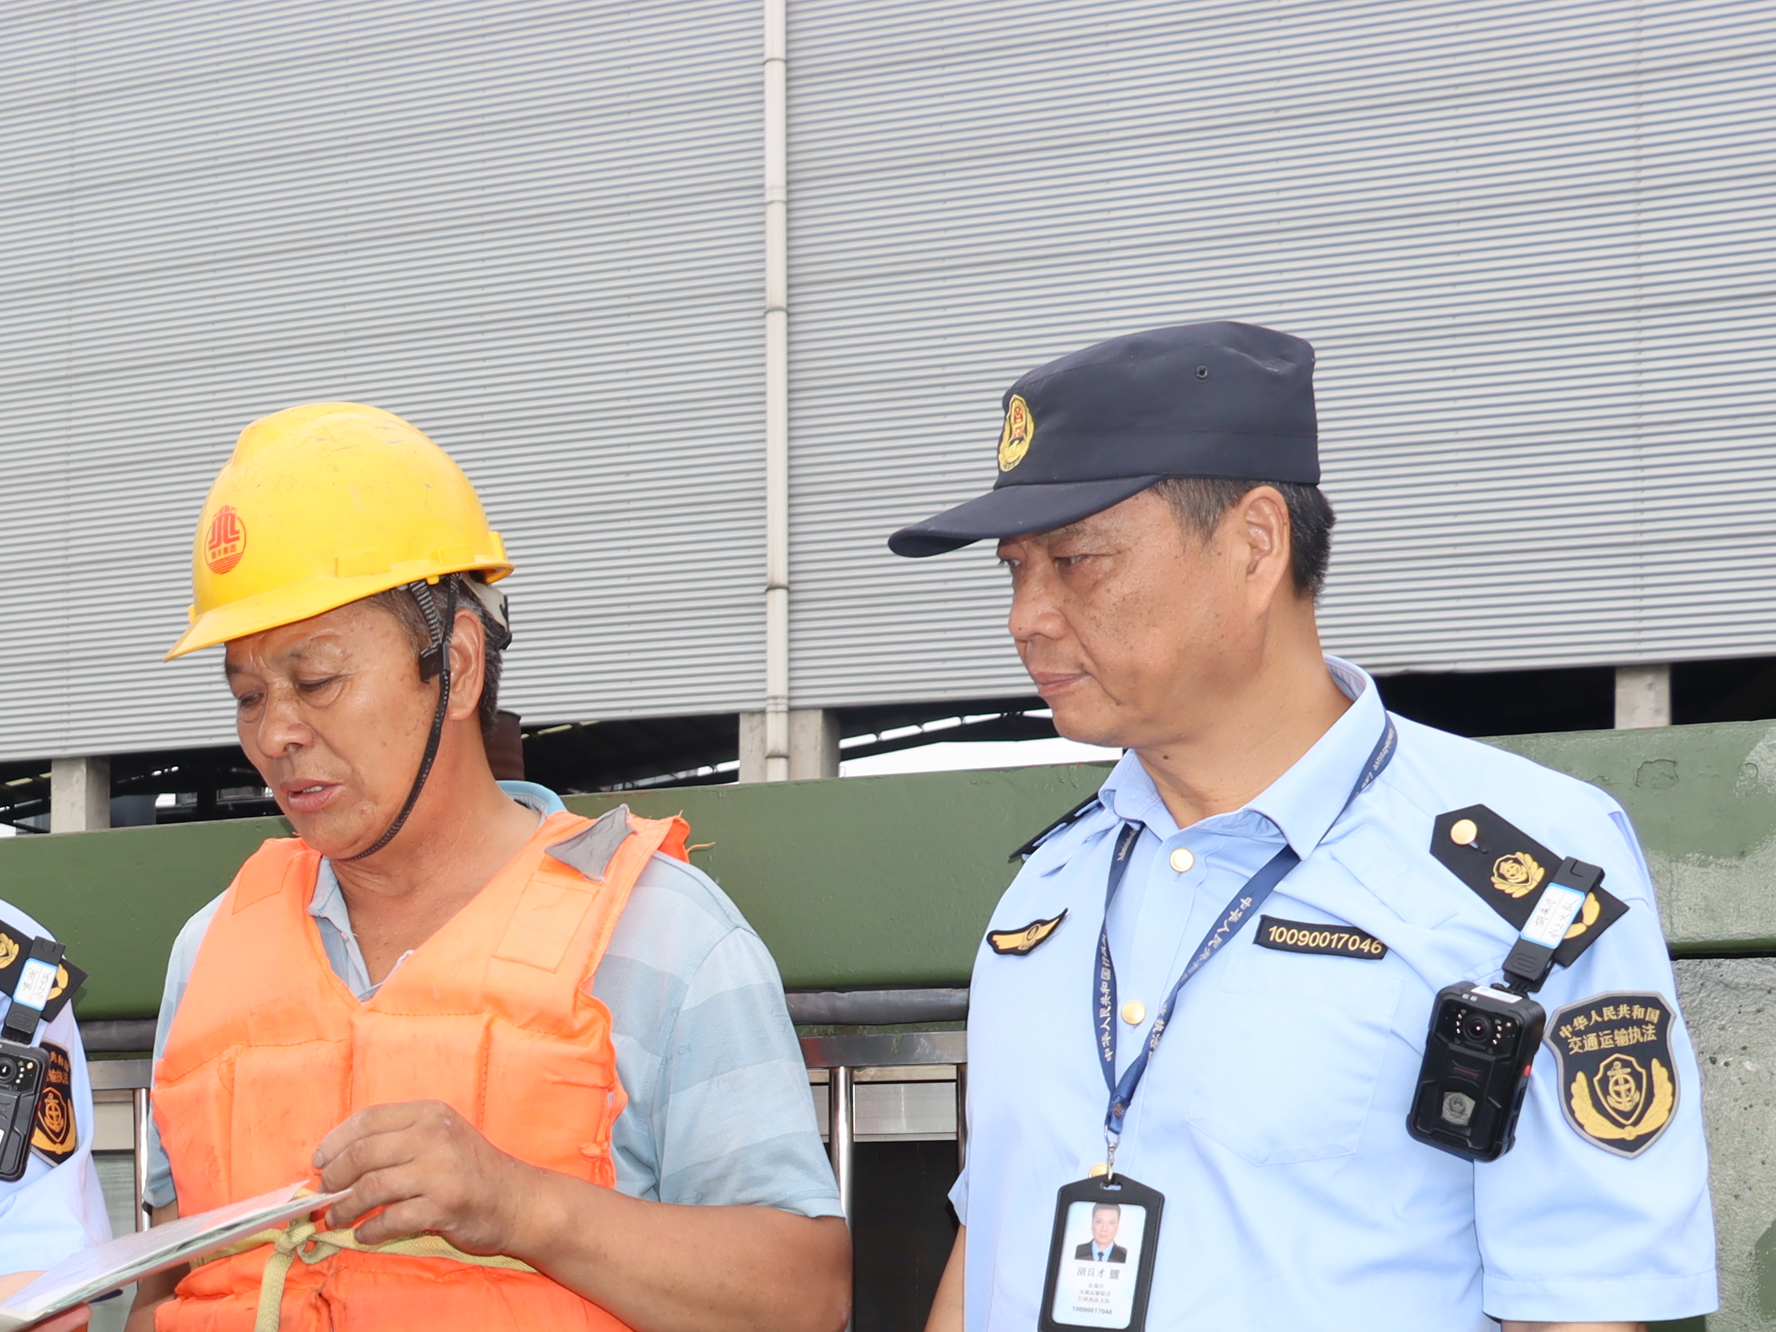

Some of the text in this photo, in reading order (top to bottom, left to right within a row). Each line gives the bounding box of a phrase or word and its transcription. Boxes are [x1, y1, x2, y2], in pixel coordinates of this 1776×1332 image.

[1268, 925, 1383, 954] 10090017046
[1558, 1003, 1661, 1038] 中华人民共和国
[1567, 1023, 1658, 1055] 交通运输执法
